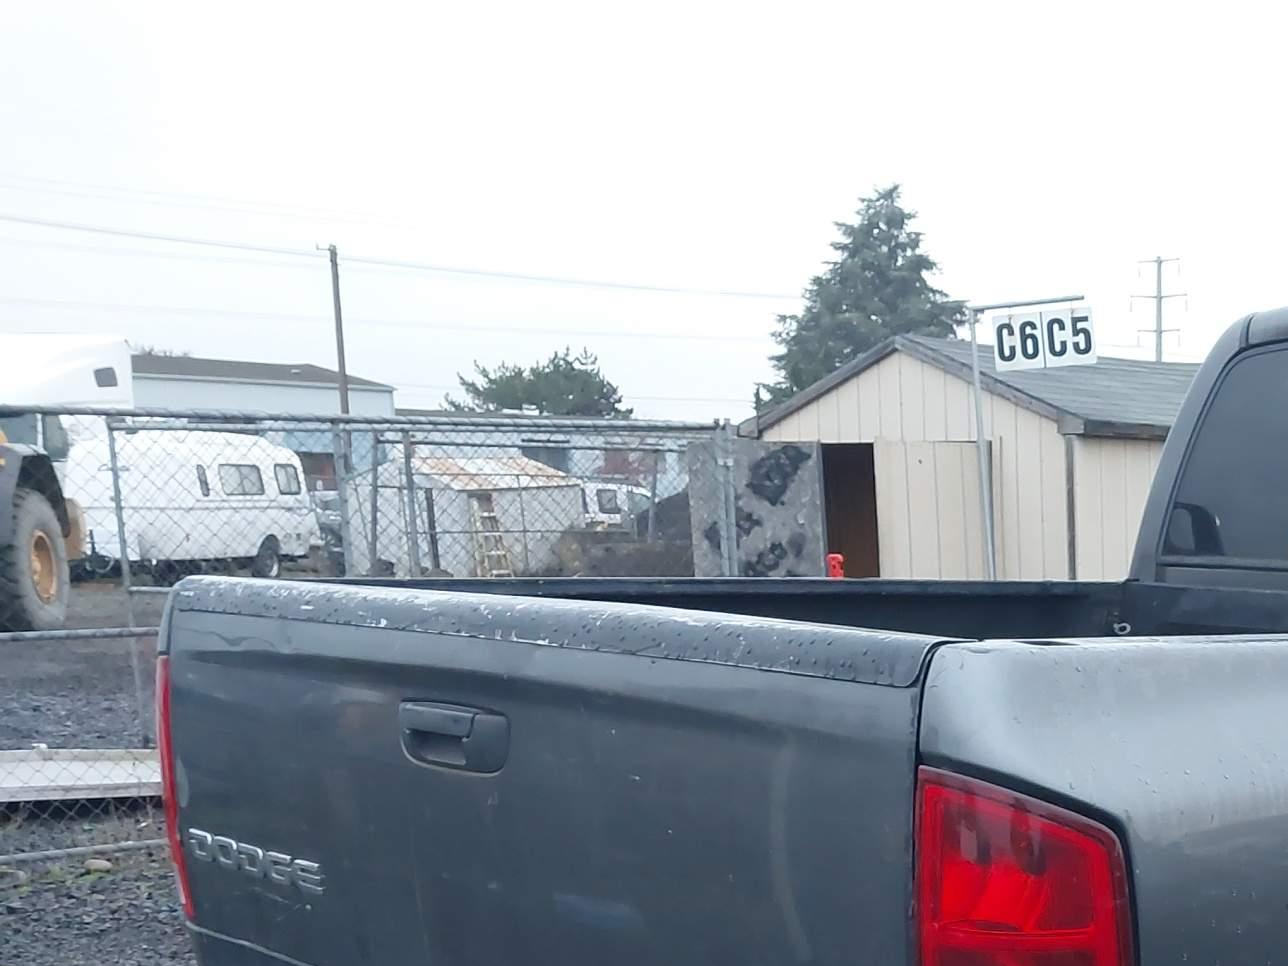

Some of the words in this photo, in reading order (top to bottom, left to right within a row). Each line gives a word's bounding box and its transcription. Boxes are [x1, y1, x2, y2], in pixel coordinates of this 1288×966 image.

[996, 320, 1040, 362] C6
[1046, 315, 1092, 357] C5
[188, 828, 326, 895] DODGE
